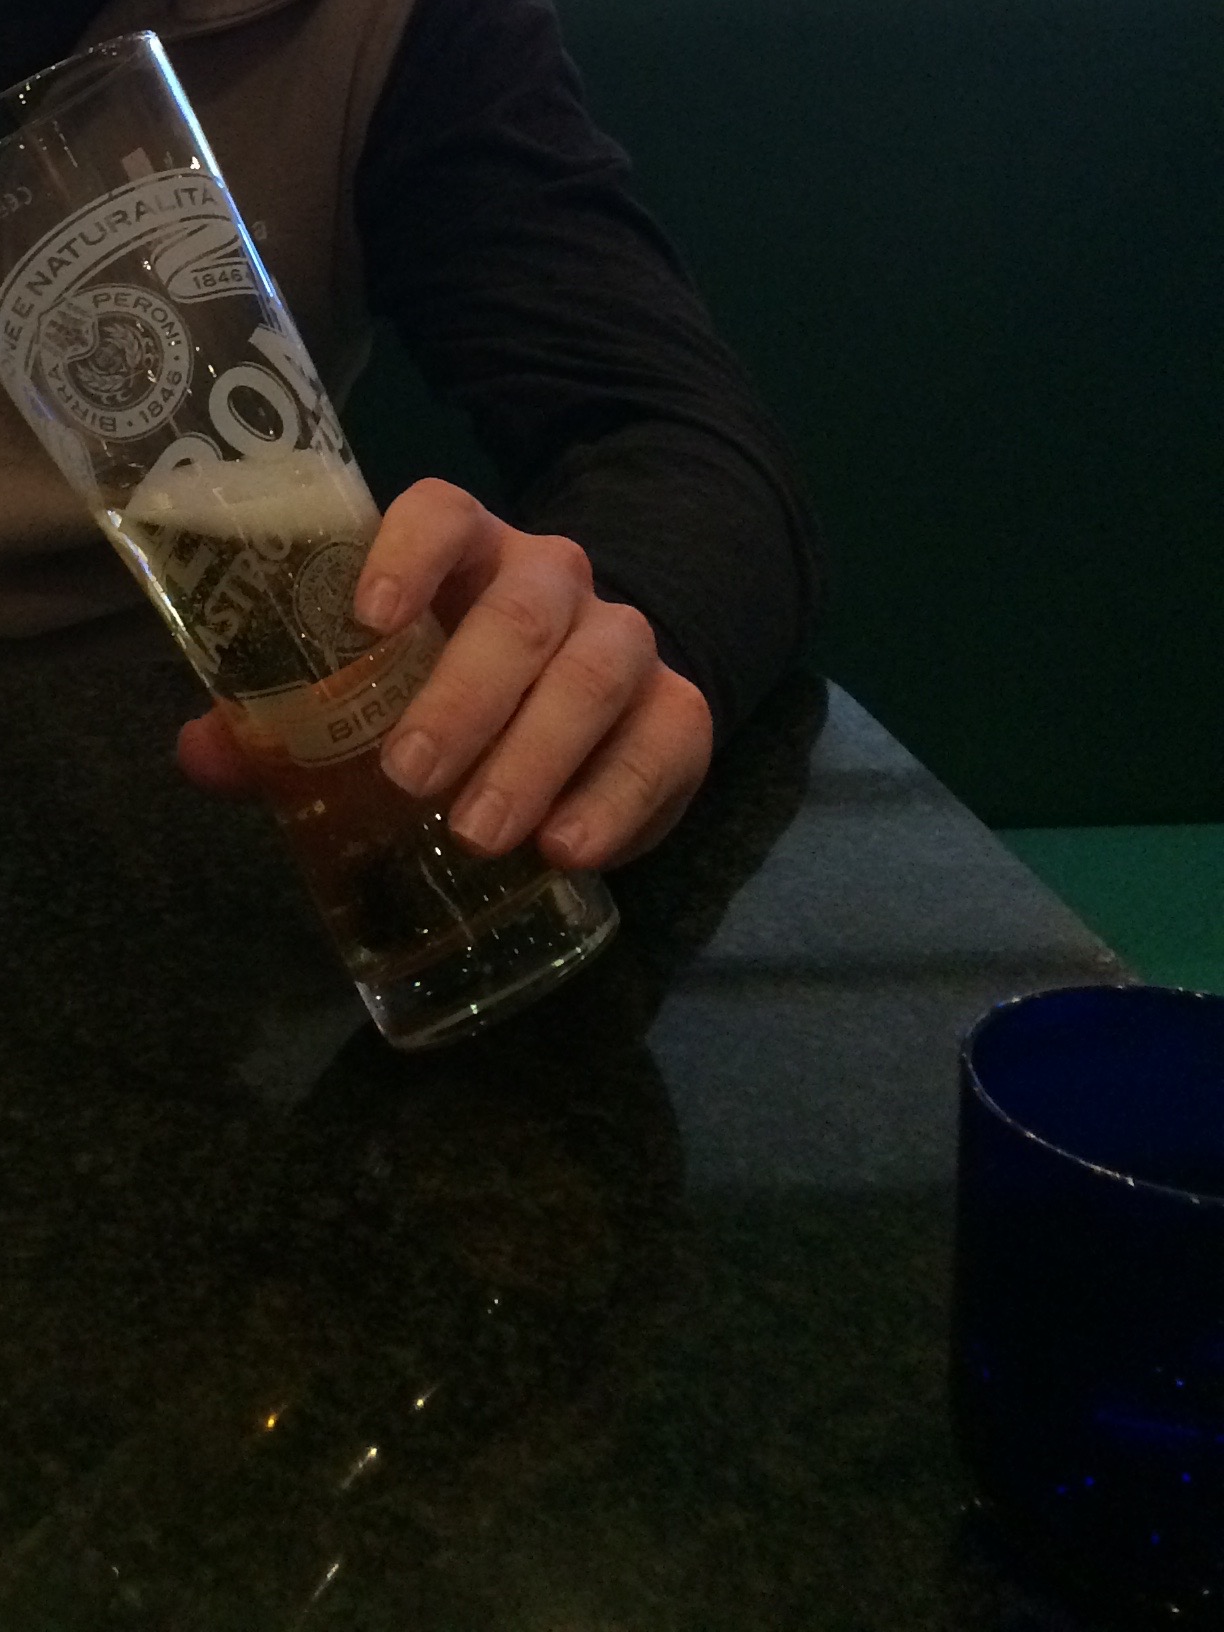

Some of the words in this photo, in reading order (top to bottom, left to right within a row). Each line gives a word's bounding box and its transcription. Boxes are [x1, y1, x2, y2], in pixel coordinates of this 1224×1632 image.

[192, 269, 243, 289] 1846
[92, 292, 182, 346] PERONI
[139, 370, 183, 423] 1846
